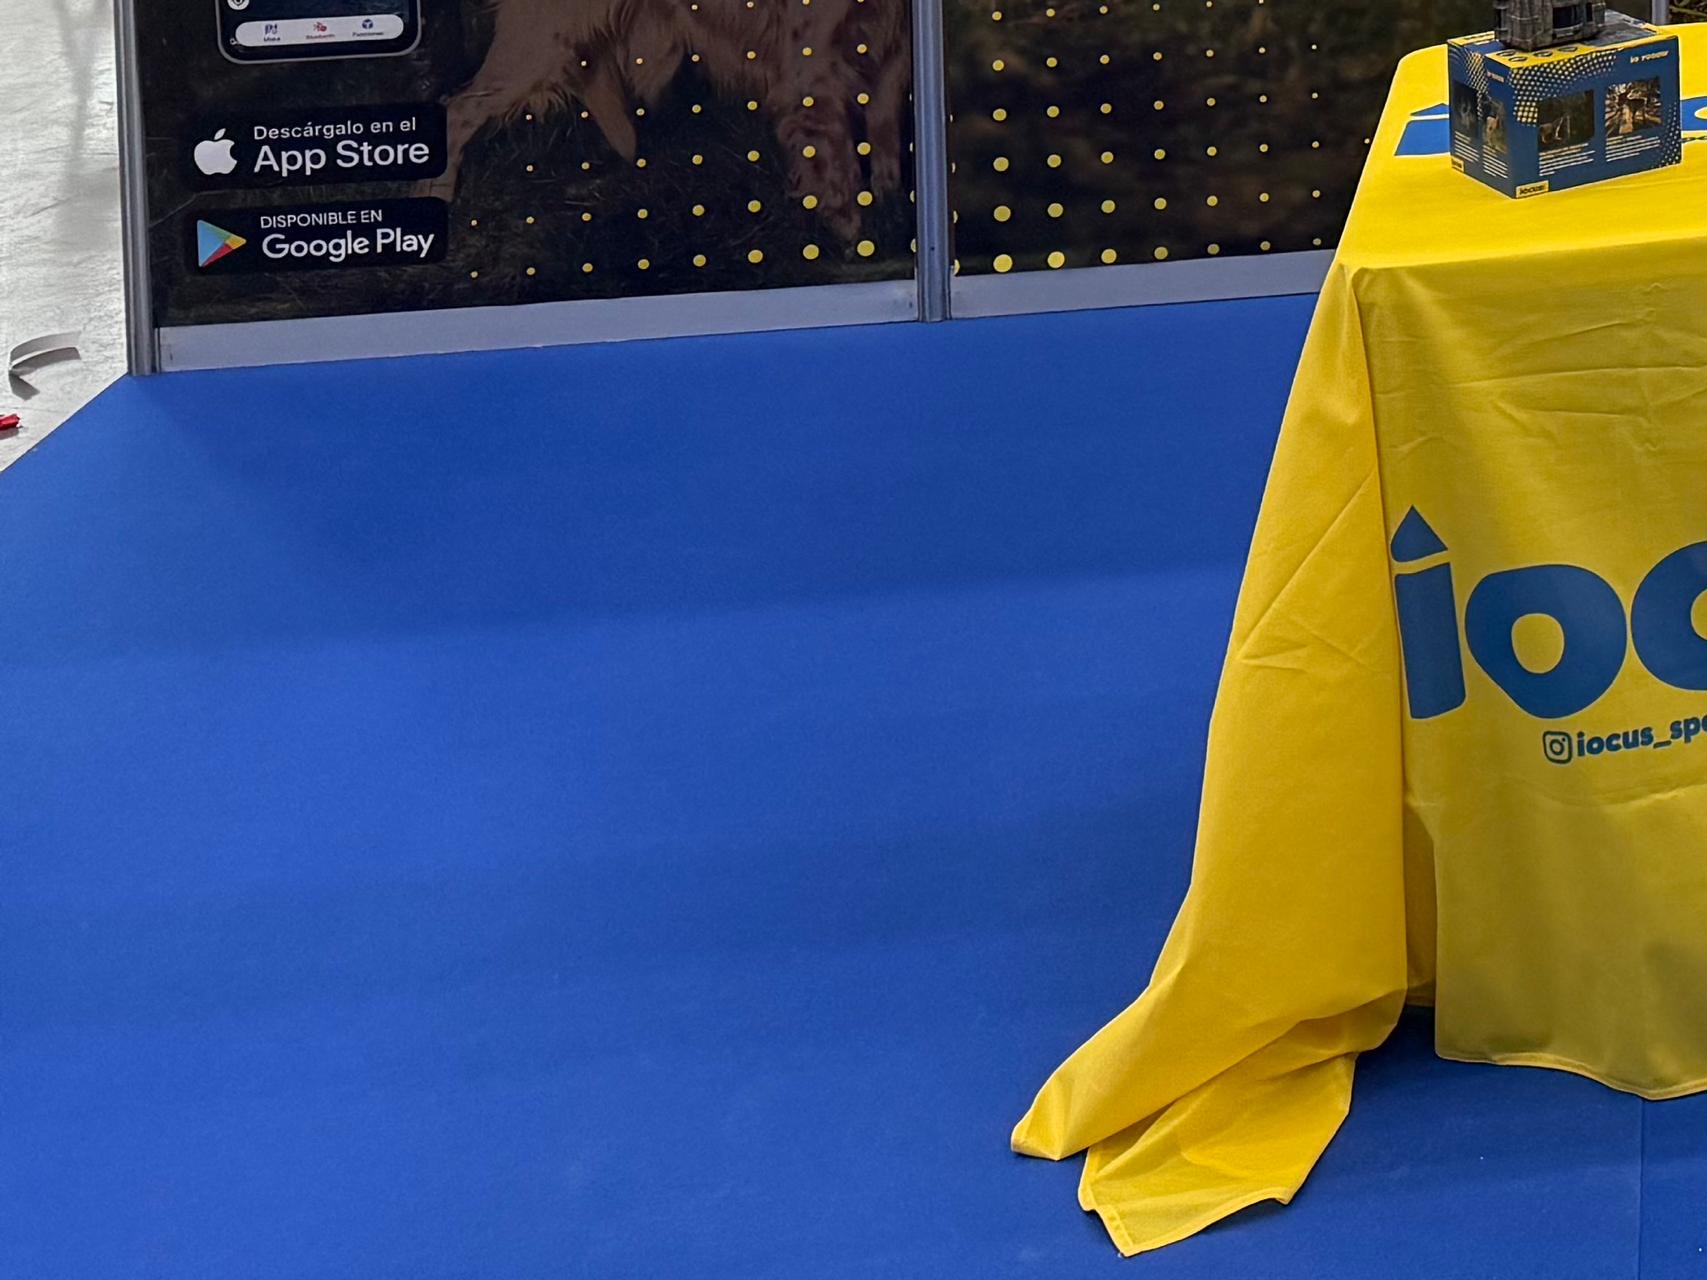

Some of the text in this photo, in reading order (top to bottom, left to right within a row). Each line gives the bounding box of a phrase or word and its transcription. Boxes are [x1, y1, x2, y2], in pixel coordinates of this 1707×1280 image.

[254, 117, 416, 141] Descárgalo en el
[254, 140, 430, 177] App Store
[261, 209, 382, 228] DISPONIBLE EN
[262, 227, 435, 262] Google Play
